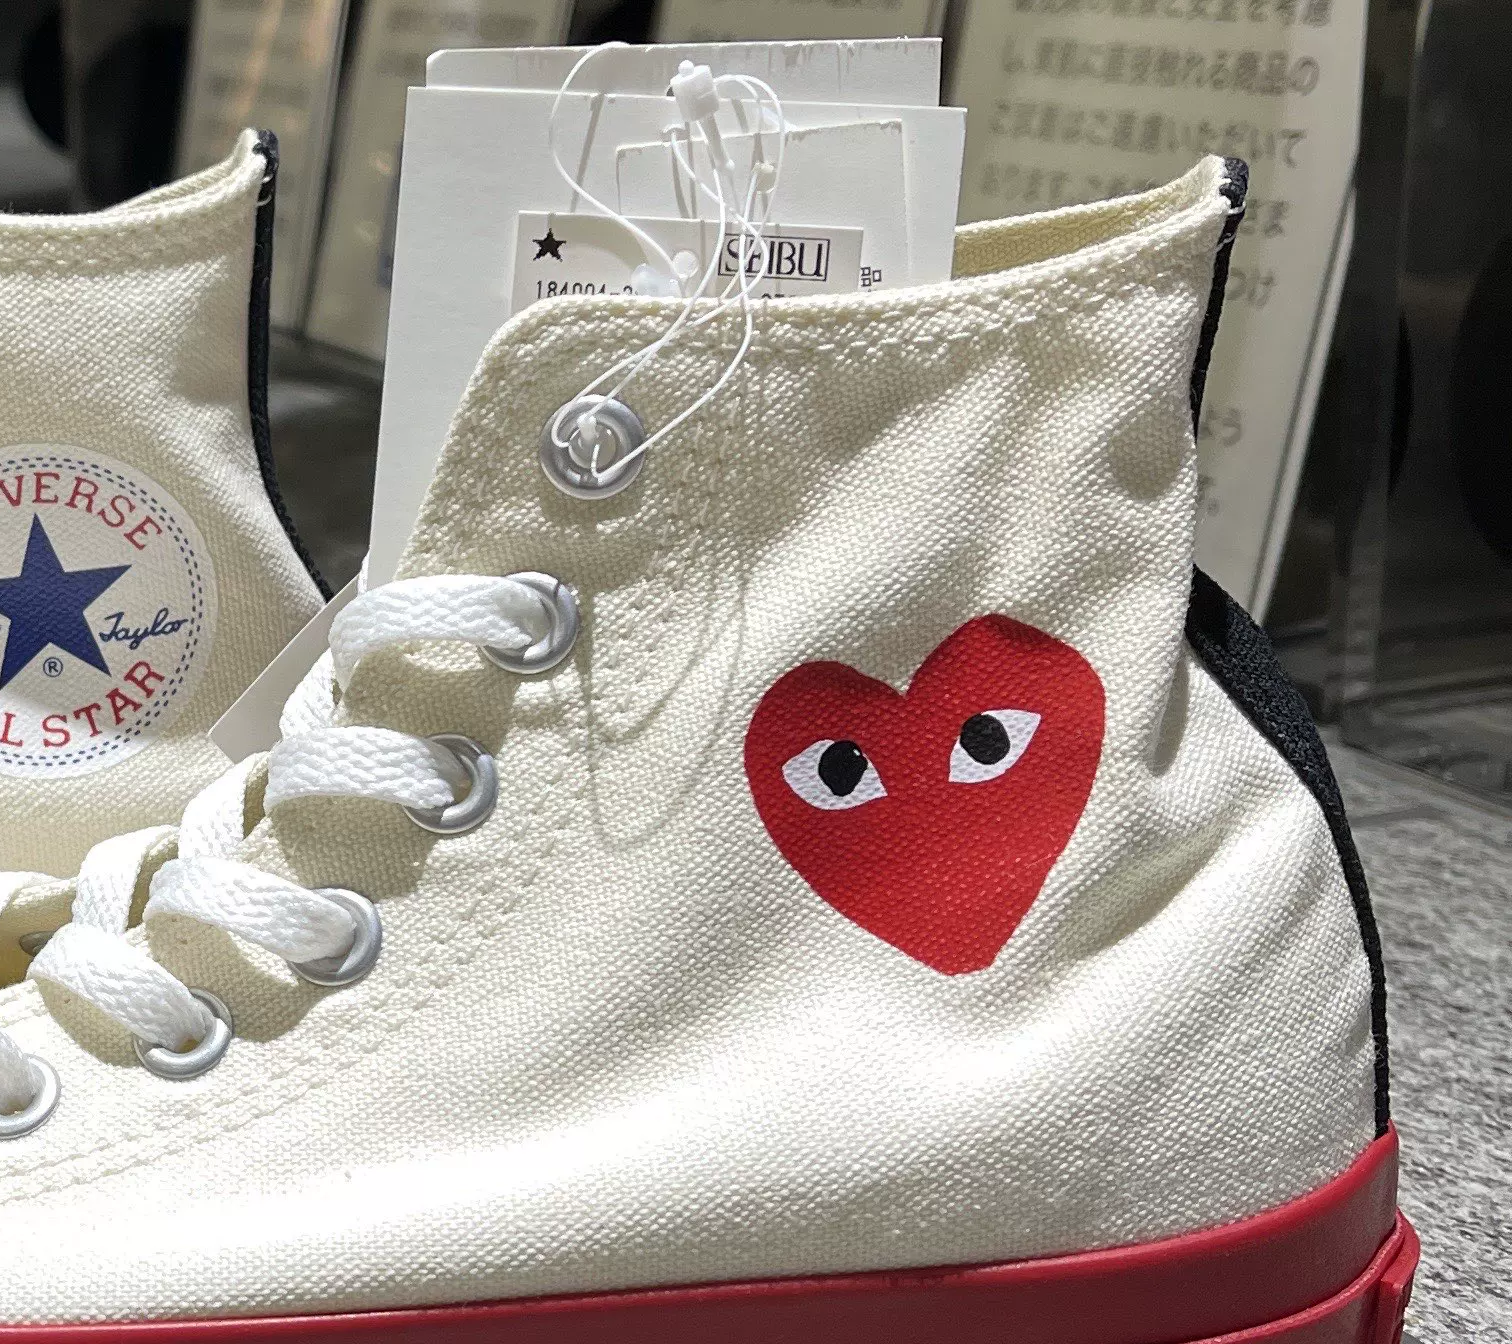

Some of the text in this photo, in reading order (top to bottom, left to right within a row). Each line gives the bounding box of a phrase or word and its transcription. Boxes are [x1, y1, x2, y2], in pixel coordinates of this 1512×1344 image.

[725, 237, 825, 278] SEIBU
[98, 606, 190, 650] Taylor
[41, 660, 166, 748] STAR
